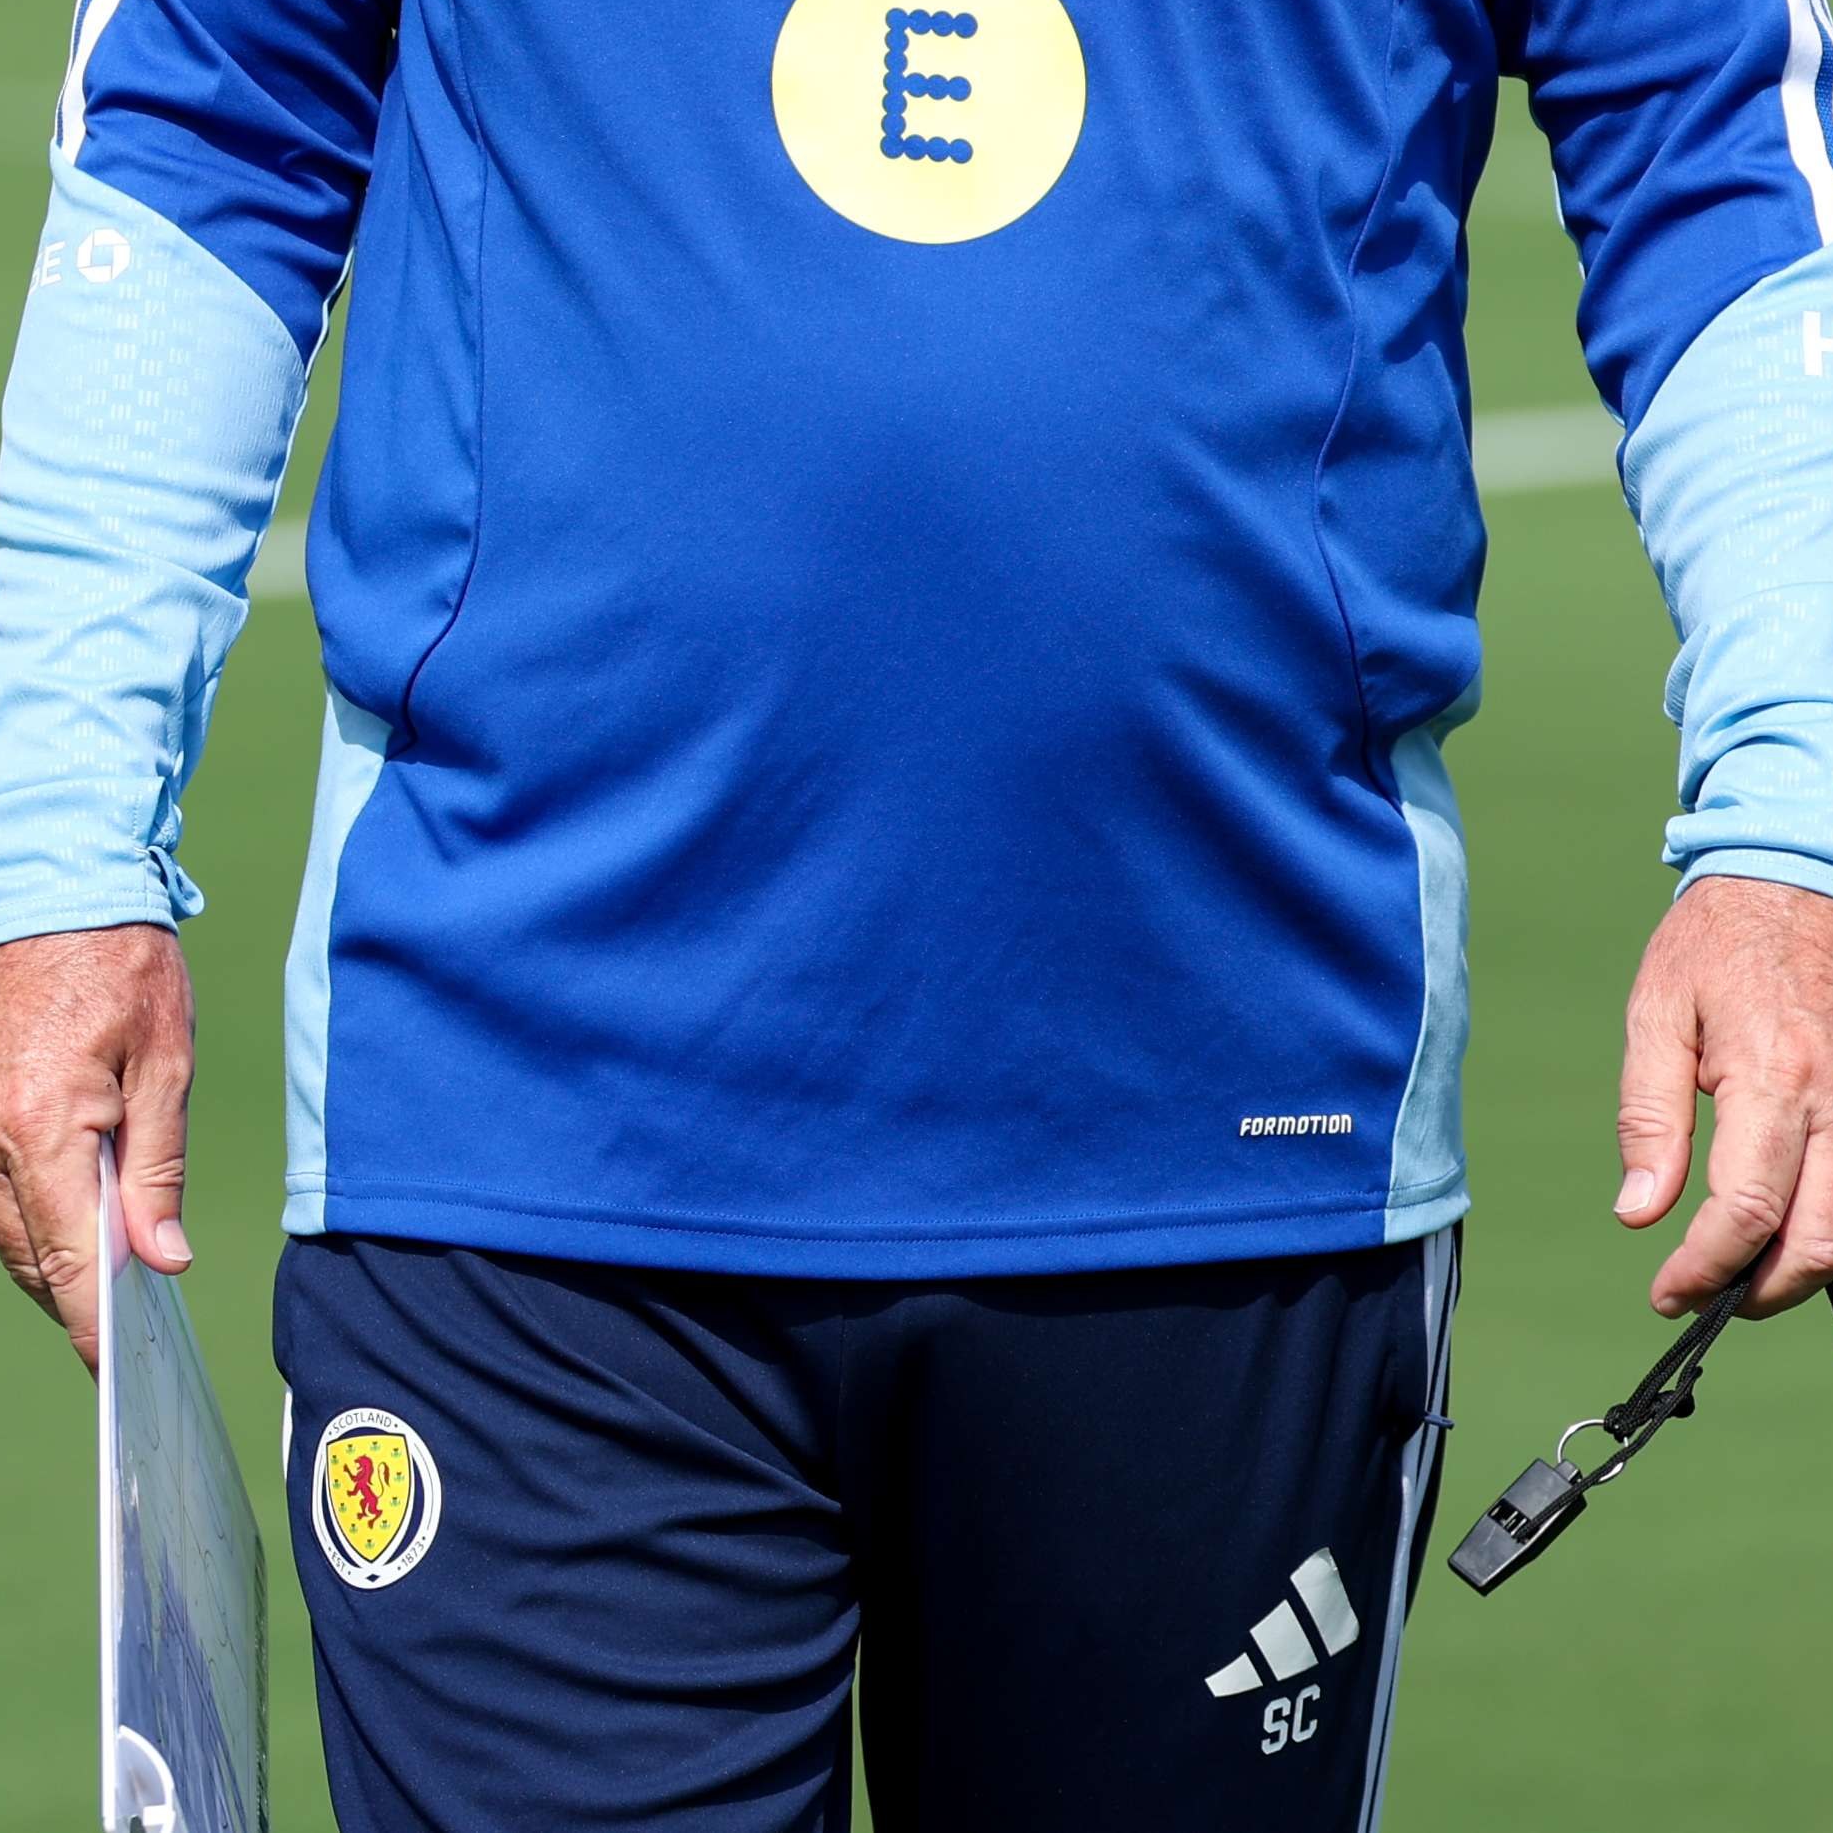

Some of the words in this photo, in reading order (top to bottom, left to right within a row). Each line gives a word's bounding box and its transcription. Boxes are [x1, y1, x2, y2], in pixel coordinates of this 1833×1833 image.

[333, 1412, 393, 1432] SCOTLAND
[331, 1552, 347, 1573] EST
[400, 1541, 425, 1568] 1873
[1261, 1684, 1321, 1755] SC
